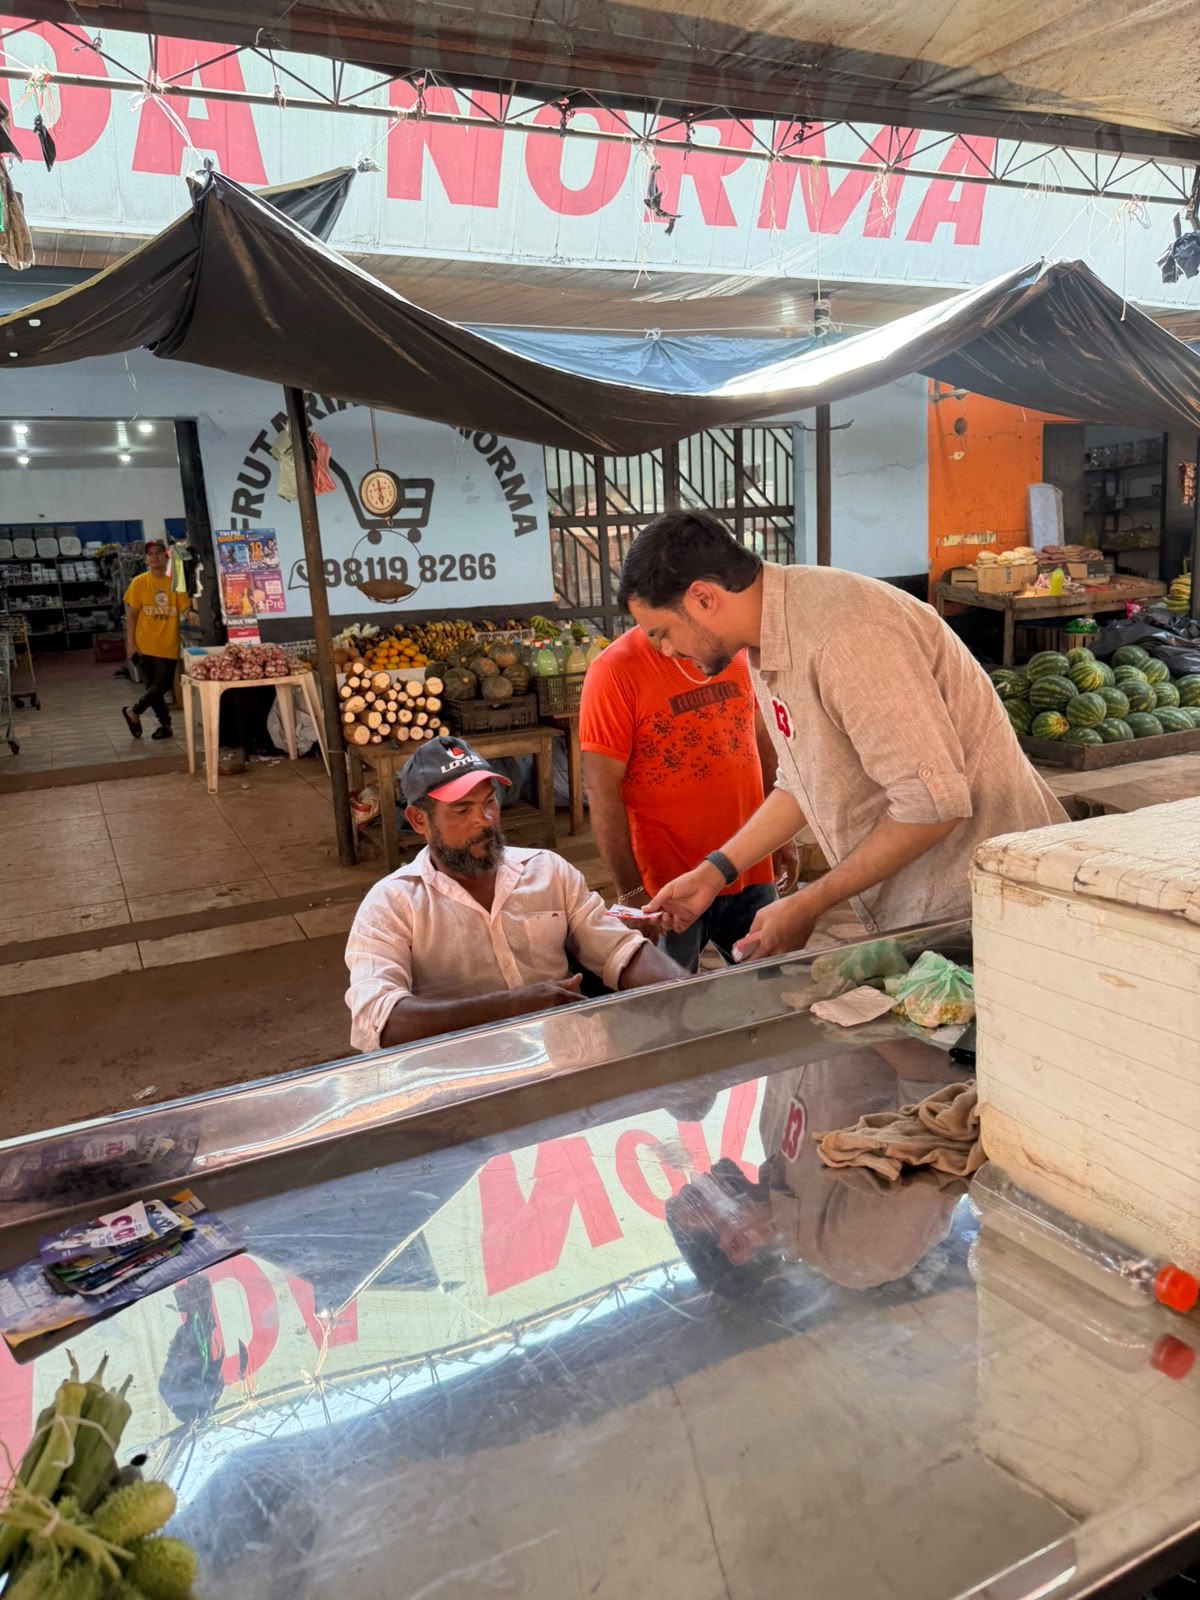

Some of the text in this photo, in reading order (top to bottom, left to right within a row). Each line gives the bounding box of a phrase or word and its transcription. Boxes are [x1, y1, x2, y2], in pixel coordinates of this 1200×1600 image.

[386, 78, 996, 246] NORMA
[230, 391, 360, 531] RUTRI
[324, 553, 497, 588] 98119 8266
